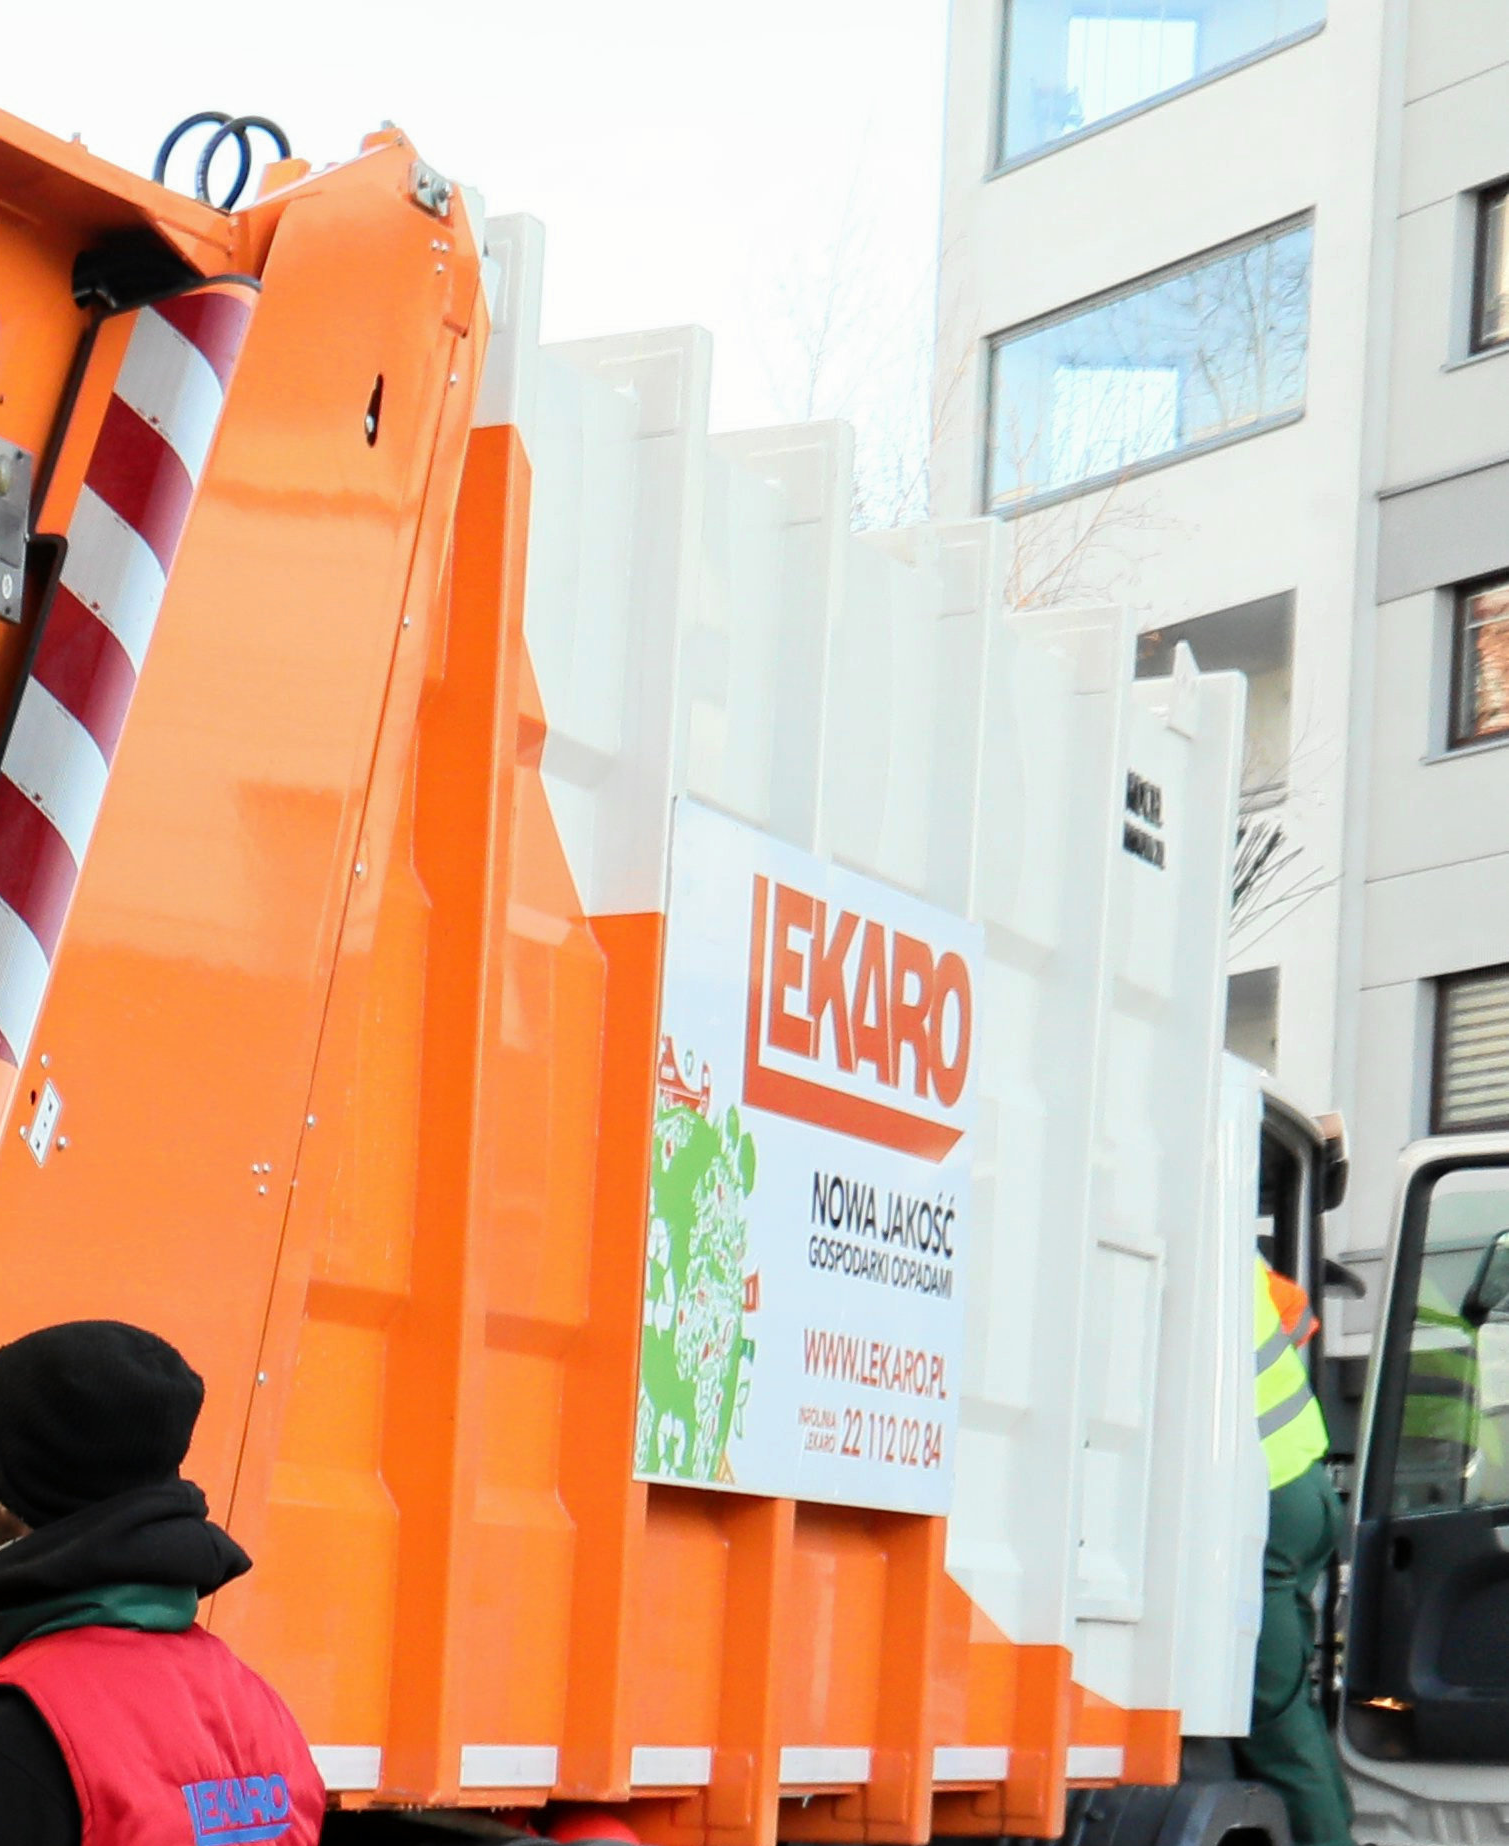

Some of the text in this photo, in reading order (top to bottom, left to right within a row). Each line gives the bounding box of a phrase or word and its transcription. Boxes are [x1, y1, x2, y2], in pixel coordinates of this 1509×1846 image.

[742, 873, 972, 1163] LEKARO
[810, 1171, 955, 1259] NOWA JAKOŚĆ
[808, 1233, 953, 1300] GOSPODARKI ODPADAMI
[804, 1327, 948, 1400] WWW.LEKARO.PL
[841, 1408, 943, 1470] 22 112 02 84
